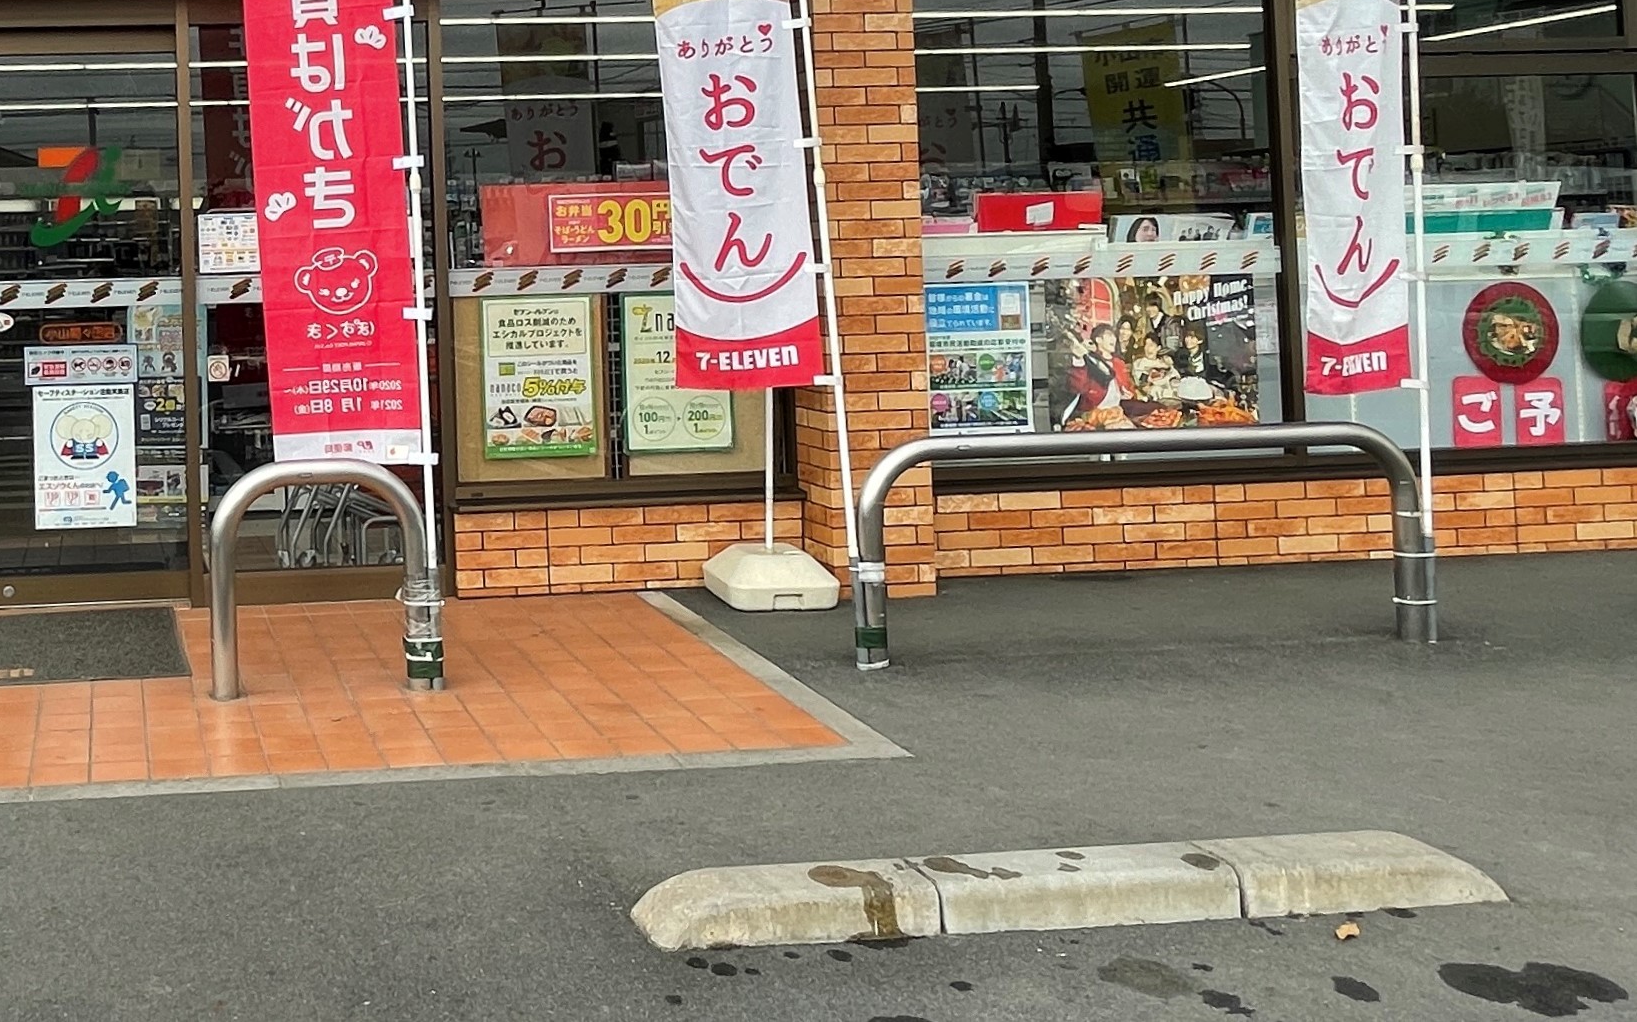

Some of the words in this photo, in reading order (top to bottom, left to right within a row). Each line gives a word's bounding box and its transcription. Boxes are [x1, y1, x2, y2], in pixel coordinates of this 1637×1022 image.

[677, 36, 773, 59] ありがとう
[699, 74, 773, 271] おでん
[1173, 285, 1210, 307] Happy
[1186, 294, 1250, 322] Christmas!
[492, 328, 583, 339] エシカルプロジェクトを
[498, 317, 577, 328] 食品ロス削減のため
